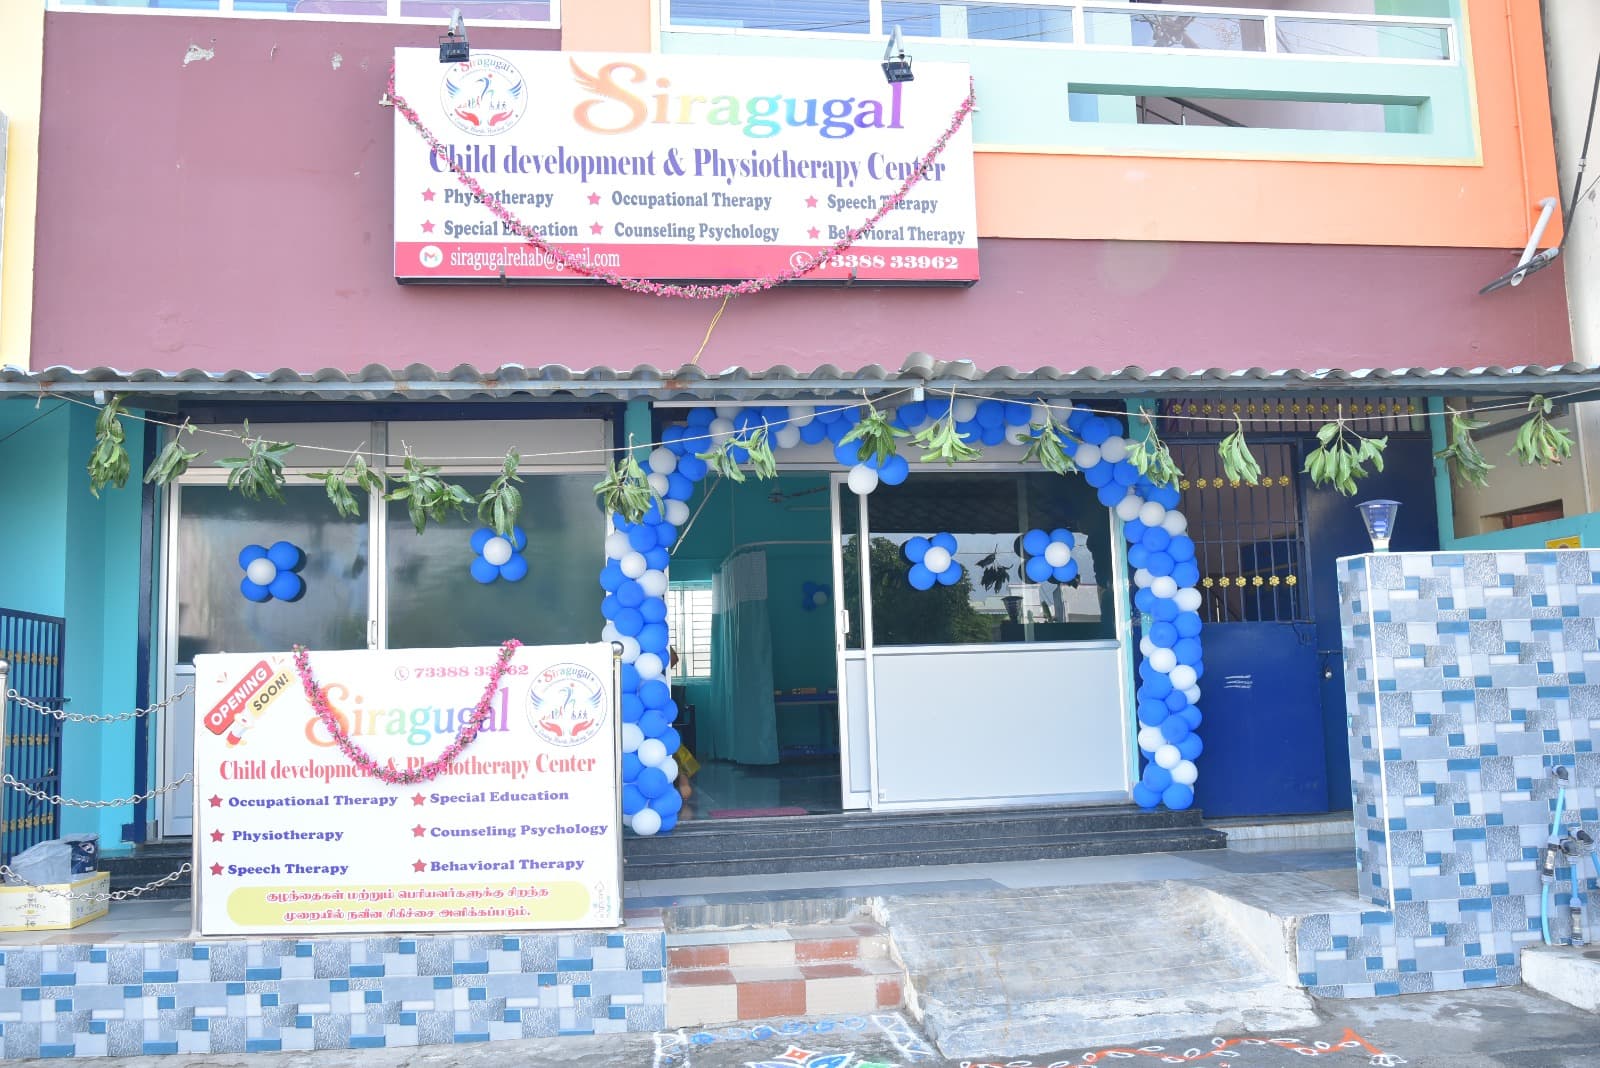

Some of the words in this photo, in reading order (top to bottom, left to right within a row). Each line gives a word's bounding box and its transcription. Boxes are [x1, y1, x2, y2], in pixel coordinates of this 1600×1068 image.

[569, 56, 905, 138] Siragugal
[429, 143, 496, 174] Child
[503, 145, 657, 183] development
[663, 147, 686, 176] &
[694, 148, 861, 188] Physiotherapy
[868, 152, 946, 182] Center
[611, 190, 708, 209] Occupational
[712, 192, 772, 210] Therapy
[827, 194, 876, 212] Speech
[444, 220, 498, 239] Special
[502, 220, 578, 236] Ecation
[614, 222, 695, 241] Counseling
[699, 223, 780, 242] Psychology
[907, 227, 966, 245] Therapy
[890, 255, 958, 269] 33962
[414, 665, 469, 678] 73388
[475, 664, 528, 677] 3362
[543, 667, 591, 682] Siragugal
[210, 667, 267, 726] OPENING
[253, 673, 289, 711] SOON!
[304, 682, 510, 746] Siragugal
[219, 760, 266, 780] Child
[536, 753, 596, 773] Center
[228, 796, 329, 808] Occupational
[333, 795, 398, 806] Therapy
[430, 792, 485, 805] Special
[489, 790, 569, 802] Education
[232, 829, 344, 842] Physiotherapy
[430, 825, 516, 838] Counseling
[520, 823, 608, 836] Psychology
[227, 864, 281, 876] Speech
[284, 863, 349, 875] Therapy
[430, 860, 514, 872] Behavioral
[519, 859, 584, 870] Therapy
[267, 889, 344, 902] குழந்தைகள்
[347, 888, 394, 901] மற்றும்
[398, 887, 505, 900] பெரியவர்களுக்கு
[507, 886, 549, 898] சிறந்த
[284, 908, 344, 921] முறையில்
[348, 908, 382, 920] நவீன
[387, 907, 435, 918] சிகிச்சை
[439, 905, 531, 918] அளிக்கப்படும்.
